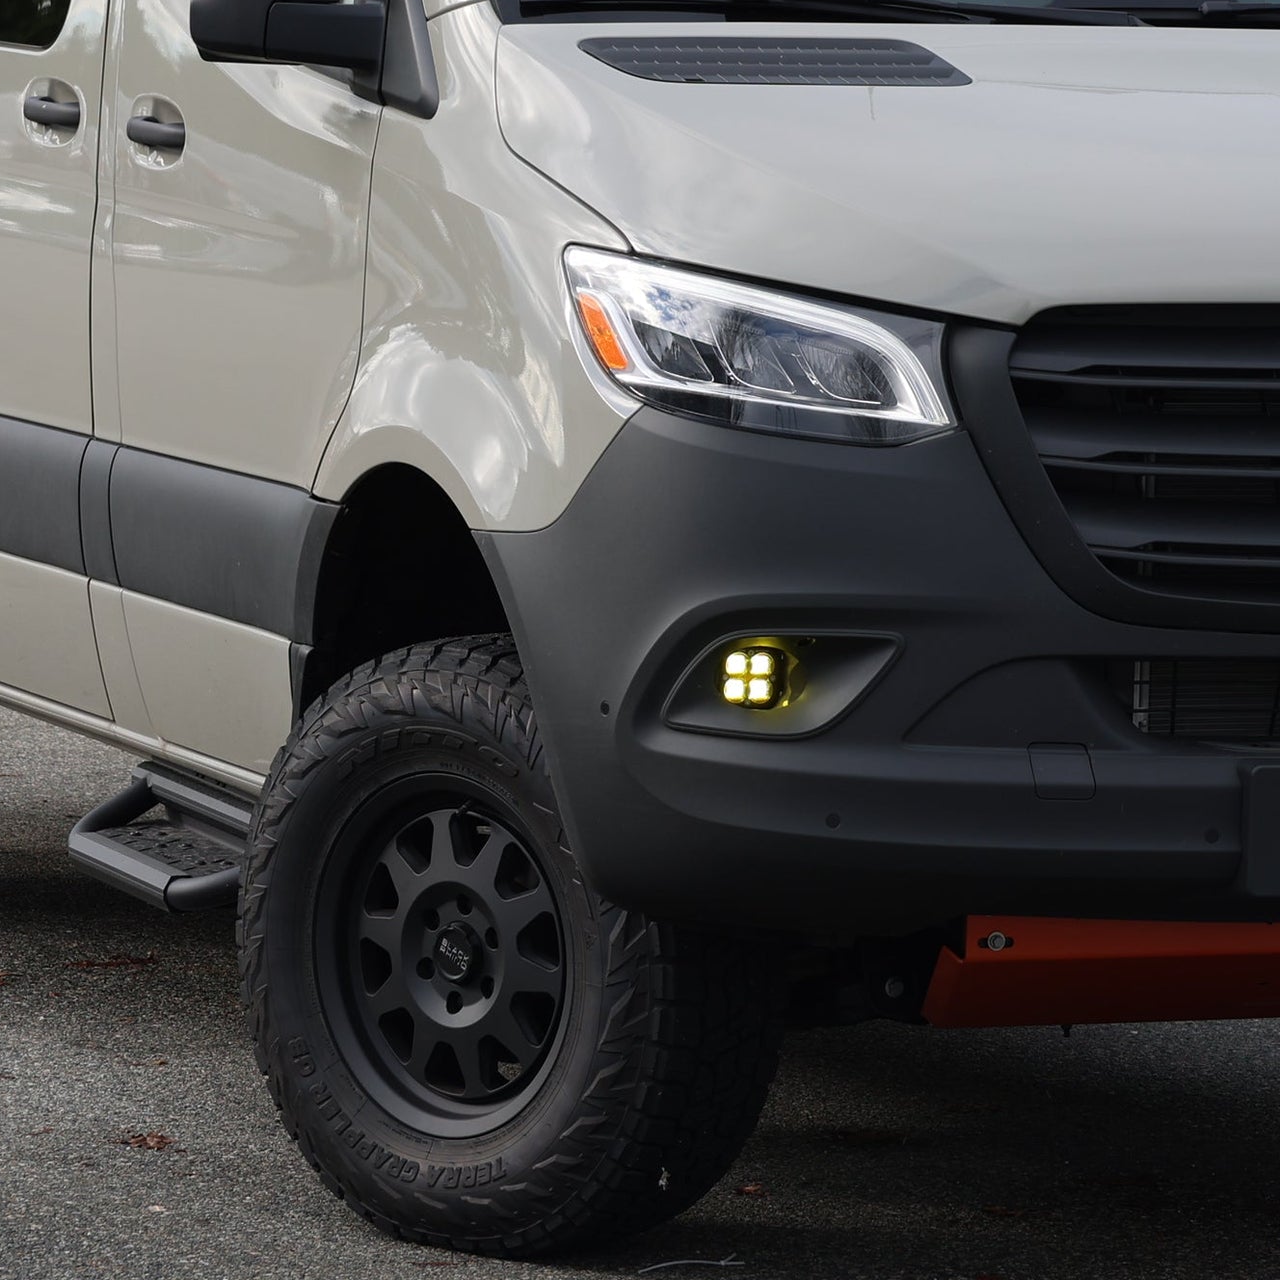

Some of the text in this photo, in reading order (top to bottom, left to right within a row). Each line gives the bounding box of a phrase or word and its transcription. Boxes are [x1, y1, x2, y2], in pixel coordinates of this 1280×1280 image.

[337, 726, 520, 780] NITTO
[308, 1080, 421, 1183] GRAPPLER
[427, 1157, 508, 1190] TERRA
